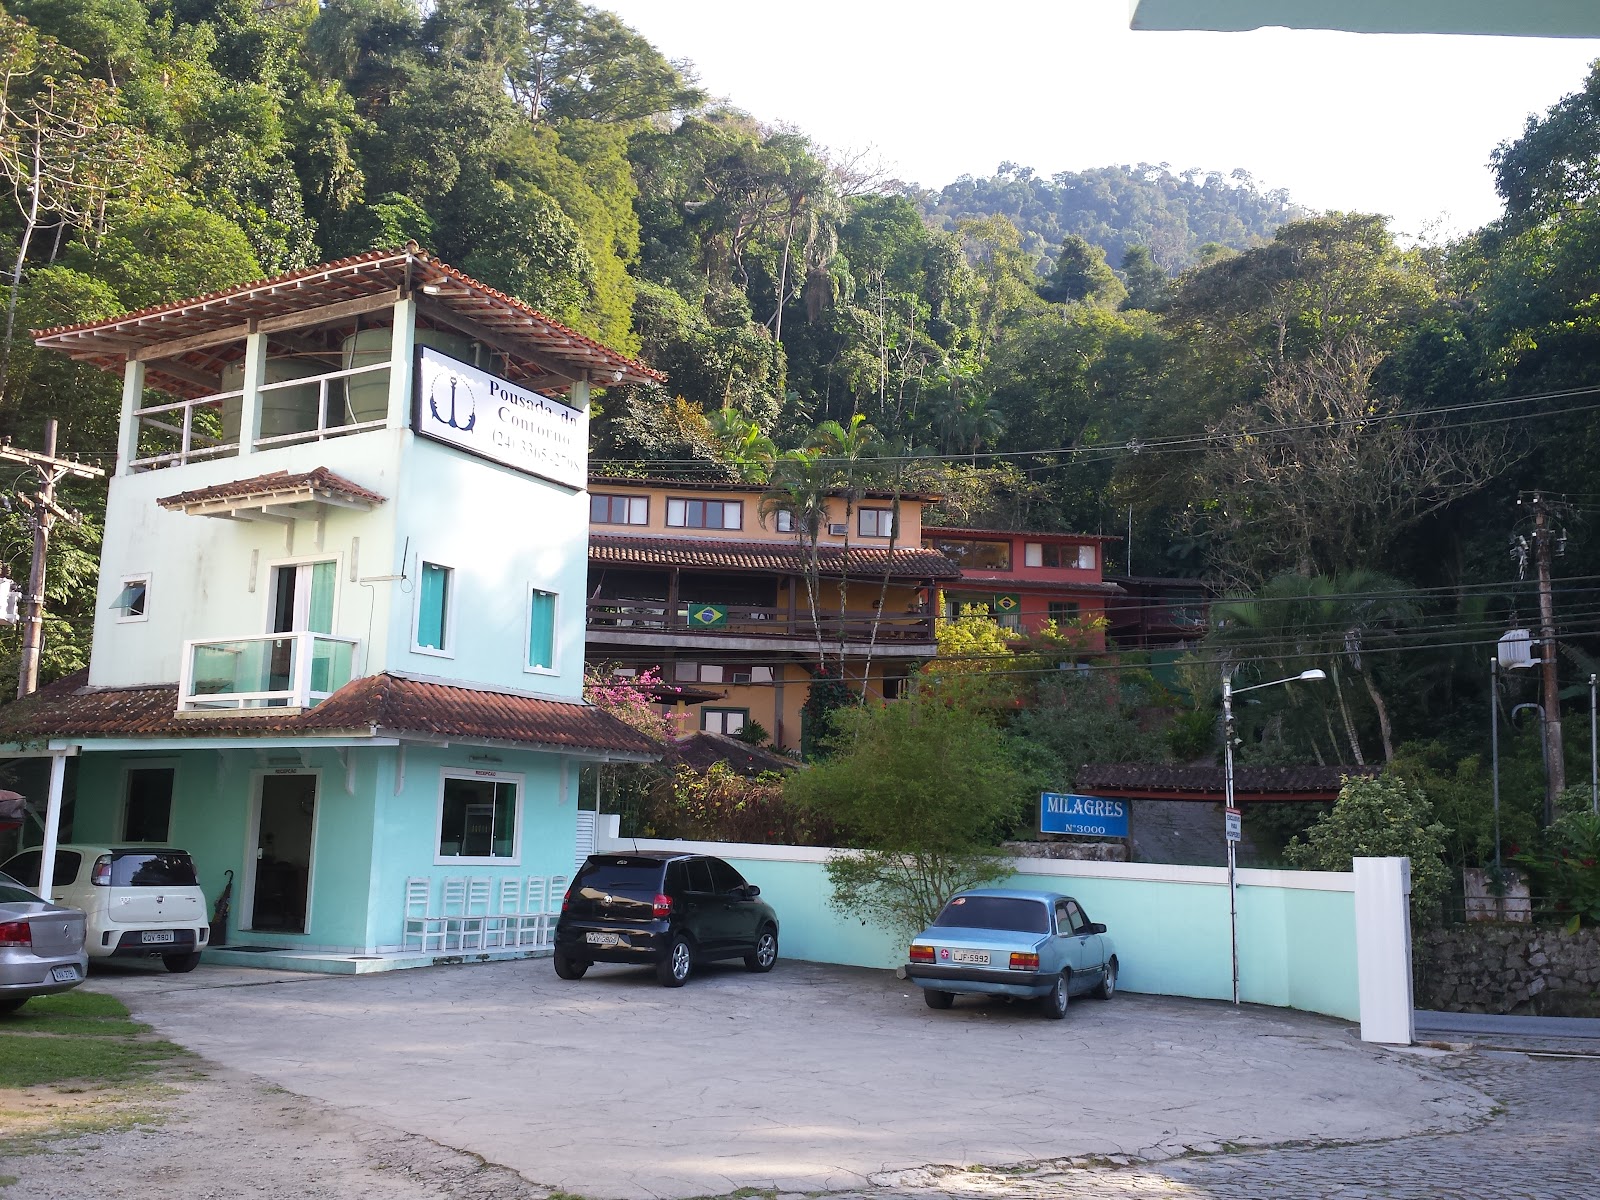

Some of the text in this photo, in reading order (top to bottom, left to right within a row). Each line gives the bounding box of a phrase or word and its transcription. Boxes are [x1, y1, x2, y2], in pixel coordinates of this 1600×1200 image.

[488, 379, 553, 418] Pousada
[497, 406, 571, 446] Contorno
[1046, 796, 1124, 818] MILAGRES
